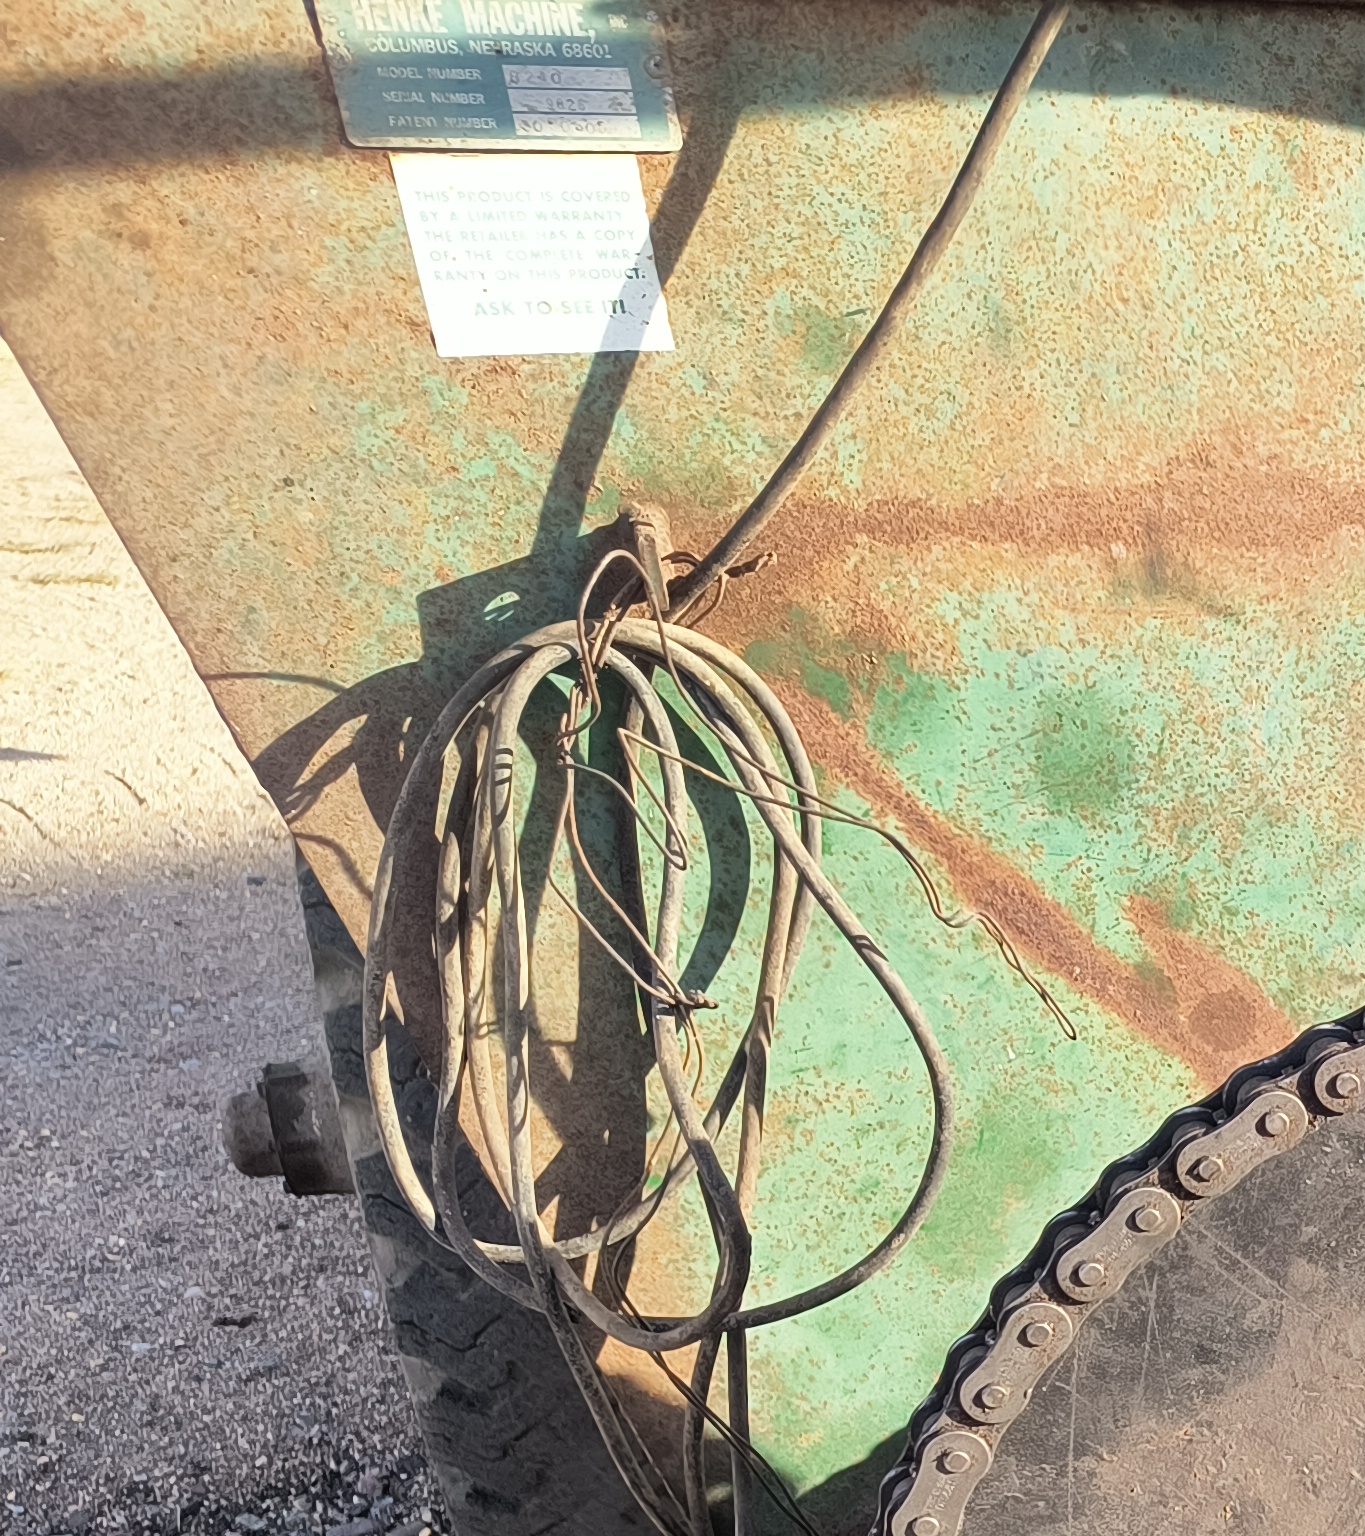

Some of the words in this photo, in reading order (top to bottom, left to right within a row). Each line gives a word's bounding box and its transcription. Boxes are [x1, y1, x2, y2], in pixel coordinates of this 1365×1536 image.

[460, 0, 596, 44] MACHINE,
[365, 37, 464, 55] COLUMBUS,
[562, 42, 612, 59] 68601
[377, 66, 423, 79] MODEL
[427, 67, 482, 80] NUMBER
[382, 91, 425, 104] SERIAL
[431, 91, 485, 104] NUMBER
[388, 115, 437, 127] PATENT
[444, 116, 498, 129] NUMBER
[414, 190, 450, 203] THIS
[457, 190, 532, 203] PRODUCT
[540, 190, 553, 203] IS
[560, 190, 631, 203] COVERED
[419, 210, 439, 223] BY
[449, 210, 459, 222] A
[467, 210, 527, 222] LIMITED
[535, 210, 624, 222] WARRANTY
[424, 230, 453, 242] THE
[460, 230, 528, 242] RETAILER
[536, 230, 568, 242] HAS
[576, 230, 586, 241] A
[594, 229, 636, 242] COPY
[464, 249, 493, 261] THE
[506, 249, 584, 261] COMPLETE
[434, 268, 486, 281] RANTY
[494, 268, 519, 281] ON
[528, 268, 561, 280] THIS
[474, 300, 516, 316] ASK
[523, 300, 552, 315] TO
[560, 300, 594, 315] SEE
